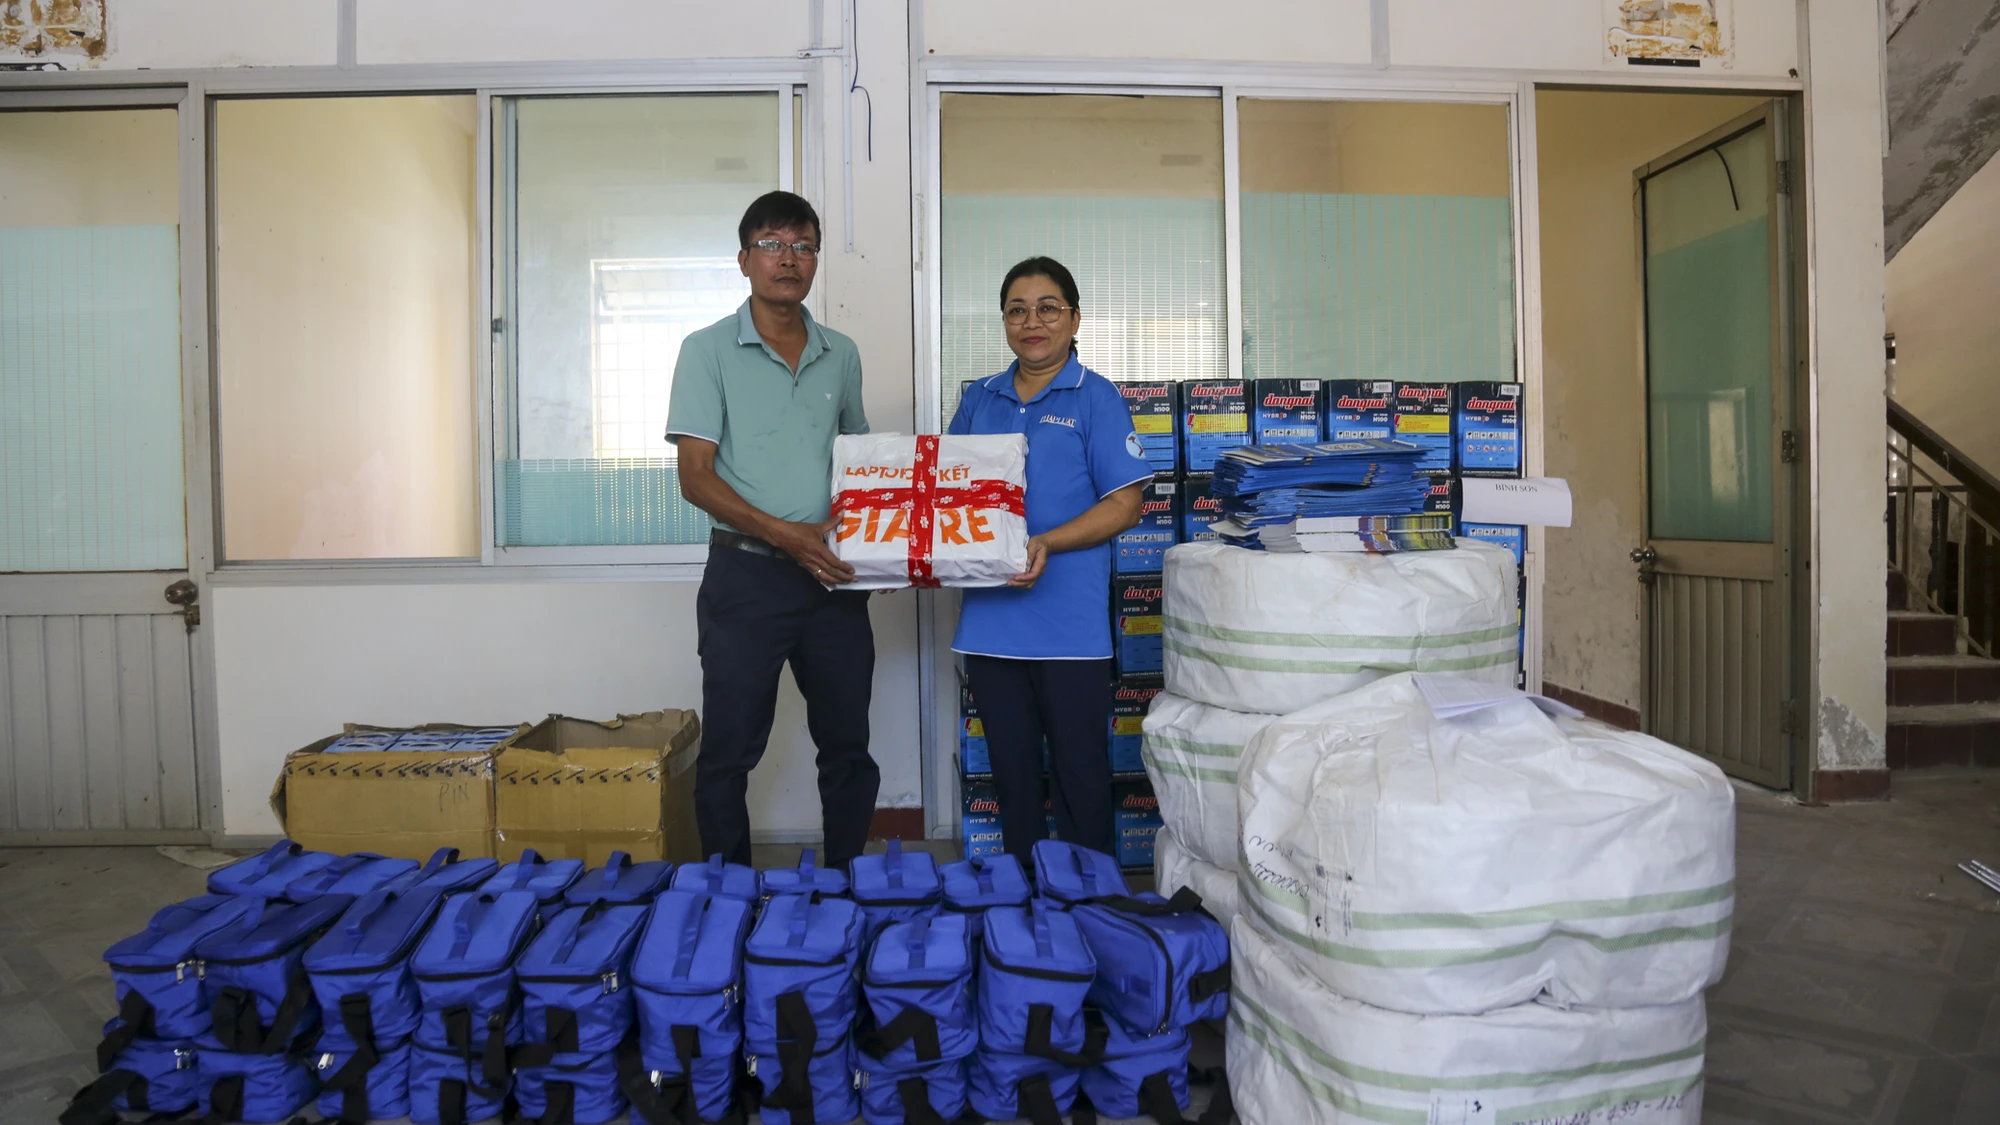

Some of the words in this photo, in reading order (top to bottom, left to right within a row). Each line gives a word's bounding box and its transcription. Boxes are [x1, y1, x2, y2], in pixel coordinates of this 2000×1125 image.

[1263, 393, 1316, 410] dongnai
[1337, 395, 1388, 412] dongnai
[1141, 498, 1172, 515] gnai
[439, 782, 471, 813] PIN
